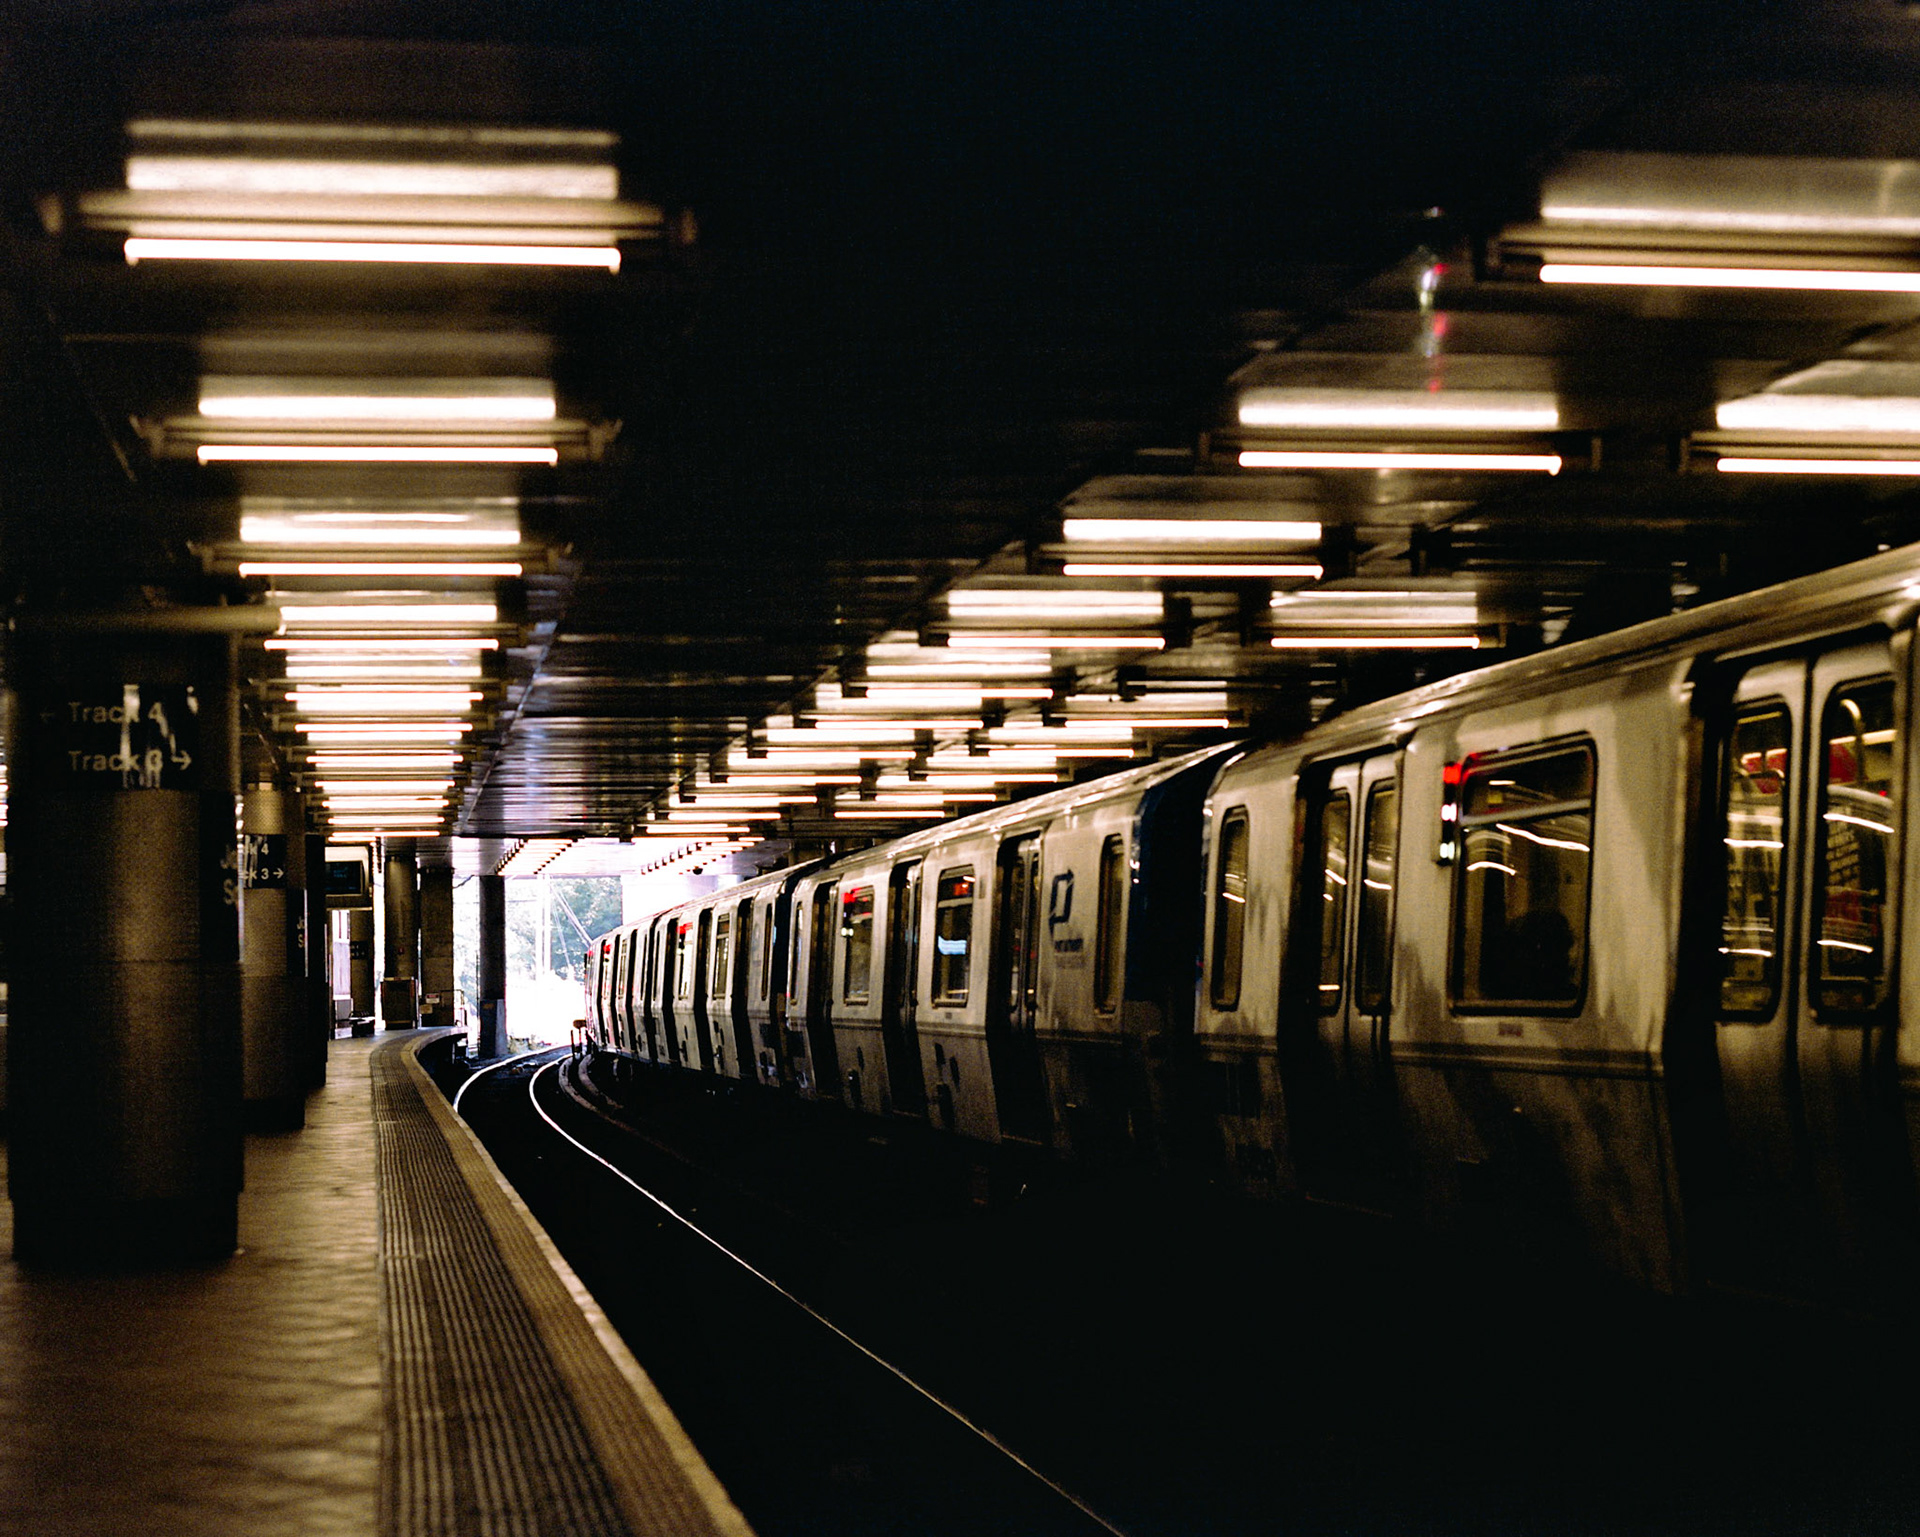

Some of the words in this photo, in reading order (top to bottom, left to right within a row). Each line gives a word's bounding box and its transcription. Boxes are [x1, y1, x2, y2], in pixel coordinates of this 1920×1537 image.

[68, 701, 141, 724] Track
[68, 749, 142, 772] Track
[260, 867, 270, 881] 3
